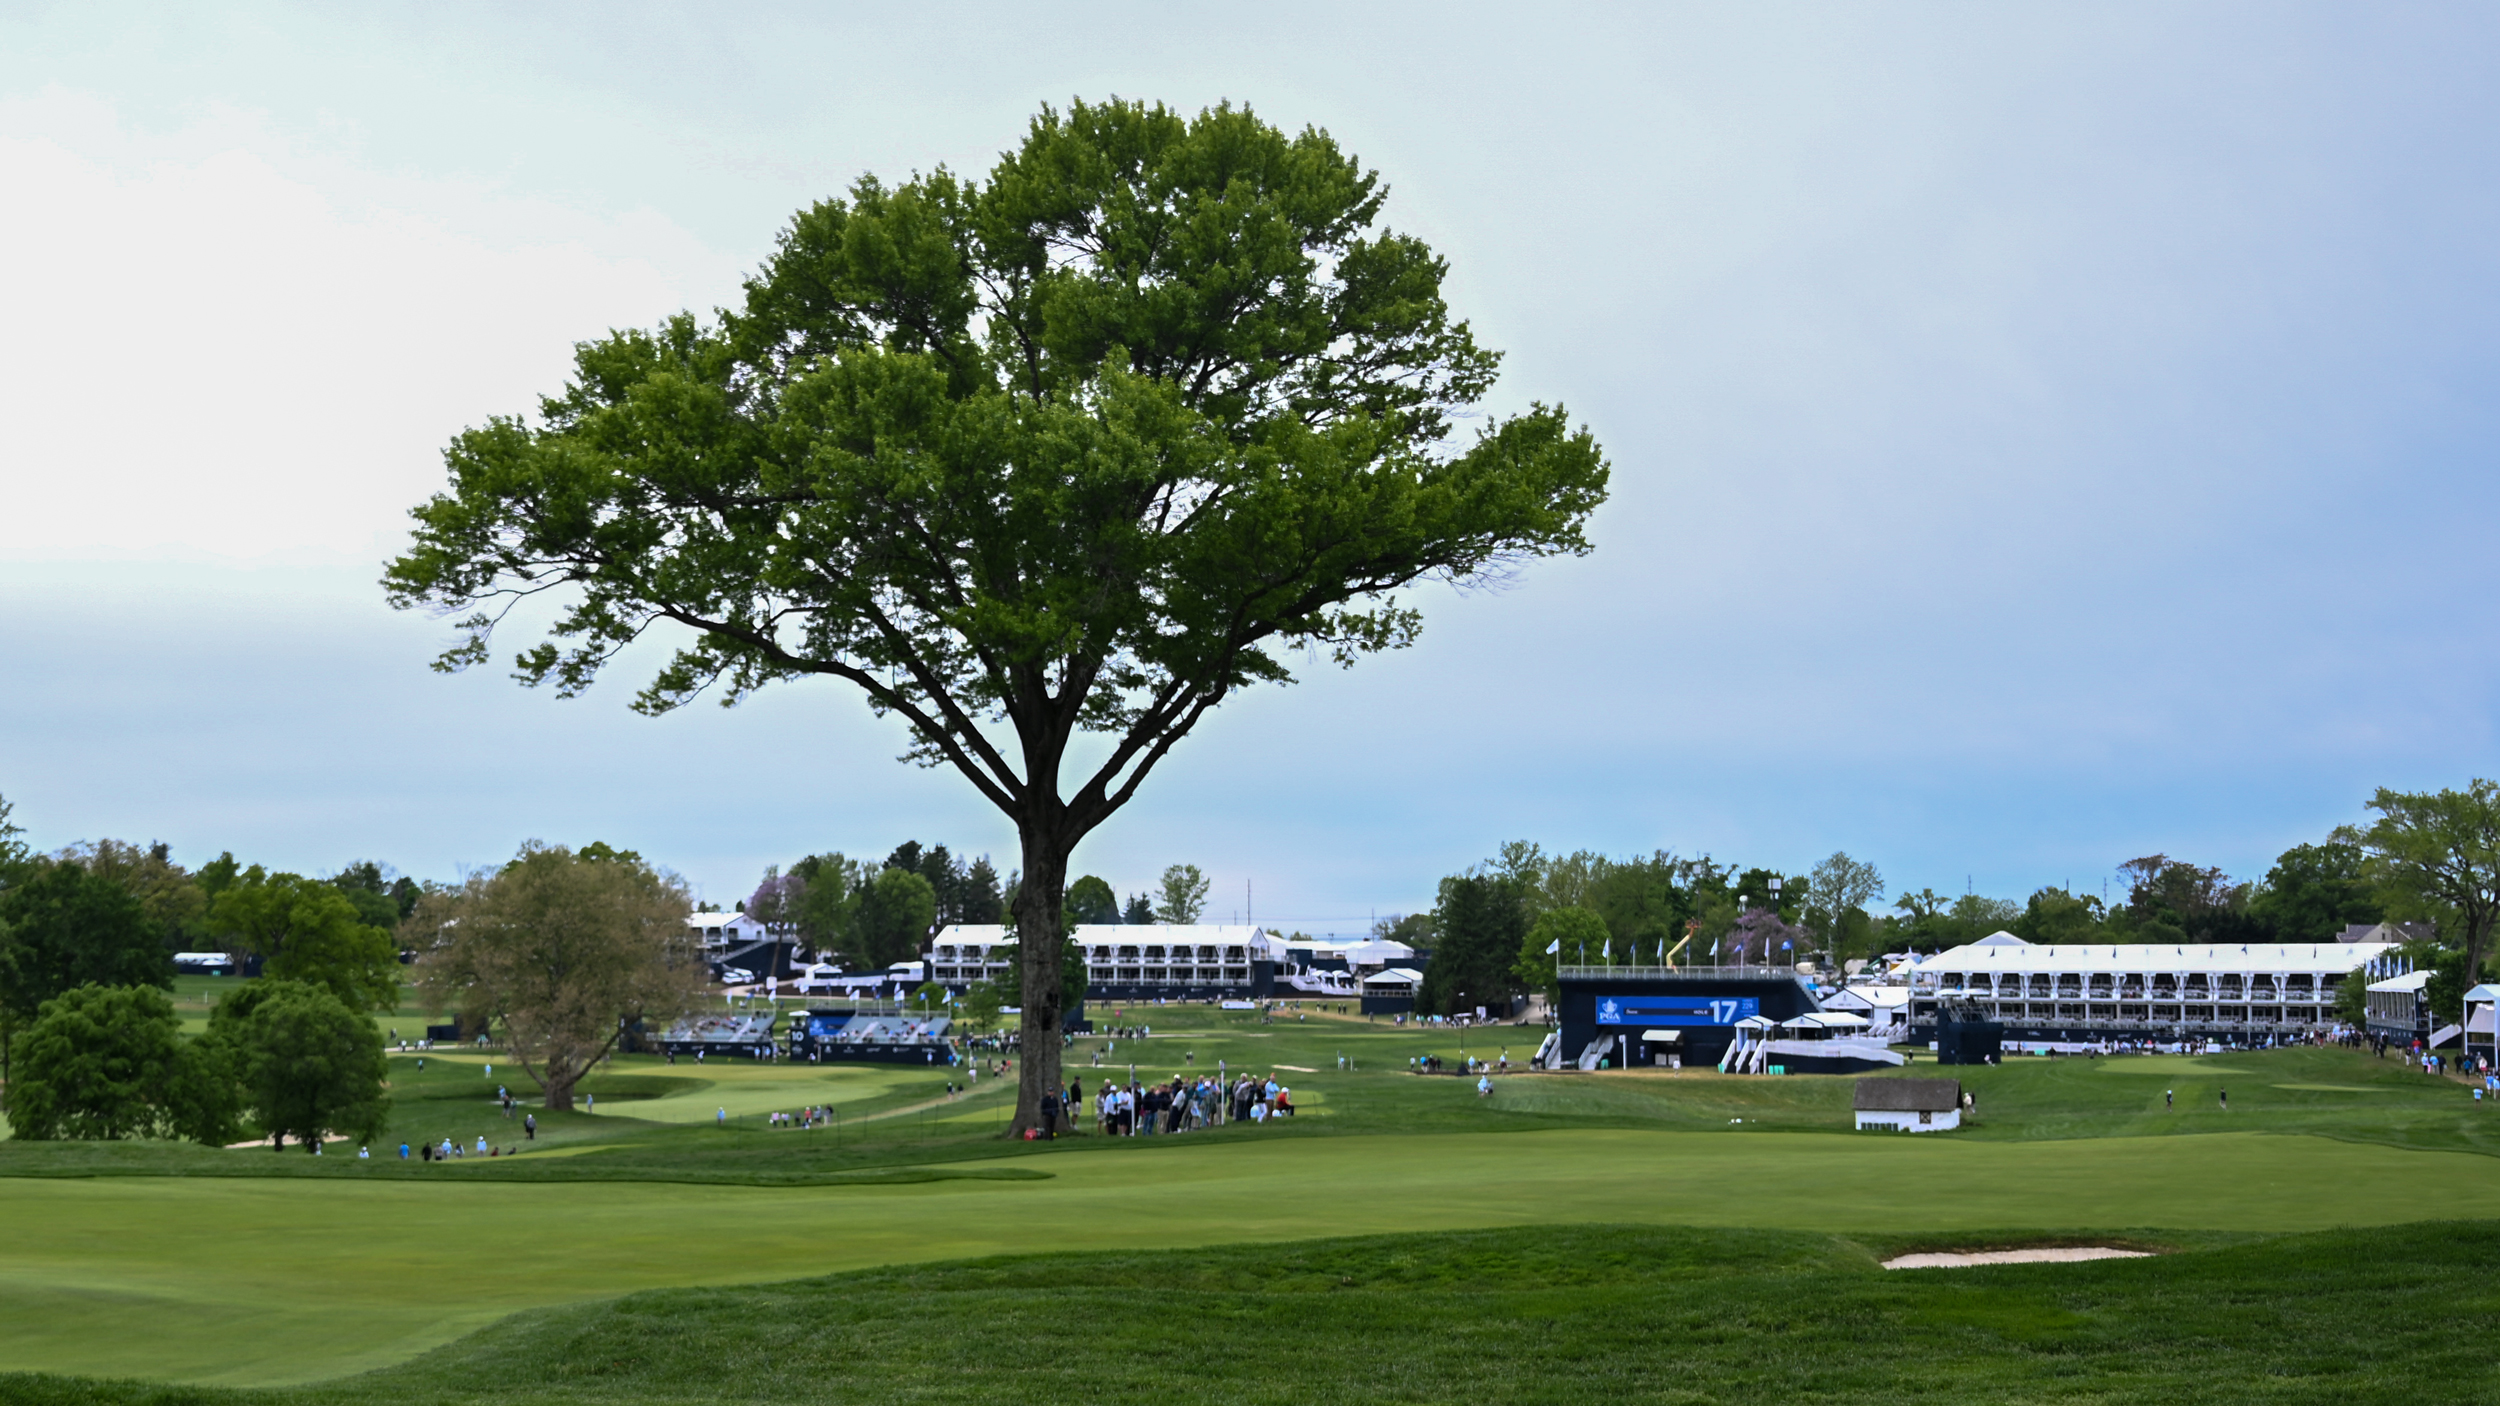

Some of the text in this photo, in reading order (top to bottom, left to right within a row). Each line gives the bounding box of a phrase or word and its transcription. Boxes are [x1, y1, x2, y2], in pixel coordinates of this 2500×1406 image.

[1599, 1012, 1620, 1020] PGA
[1709, 1000, 1737, 1023] 17
[792, 1031, 804, 1041] 10
